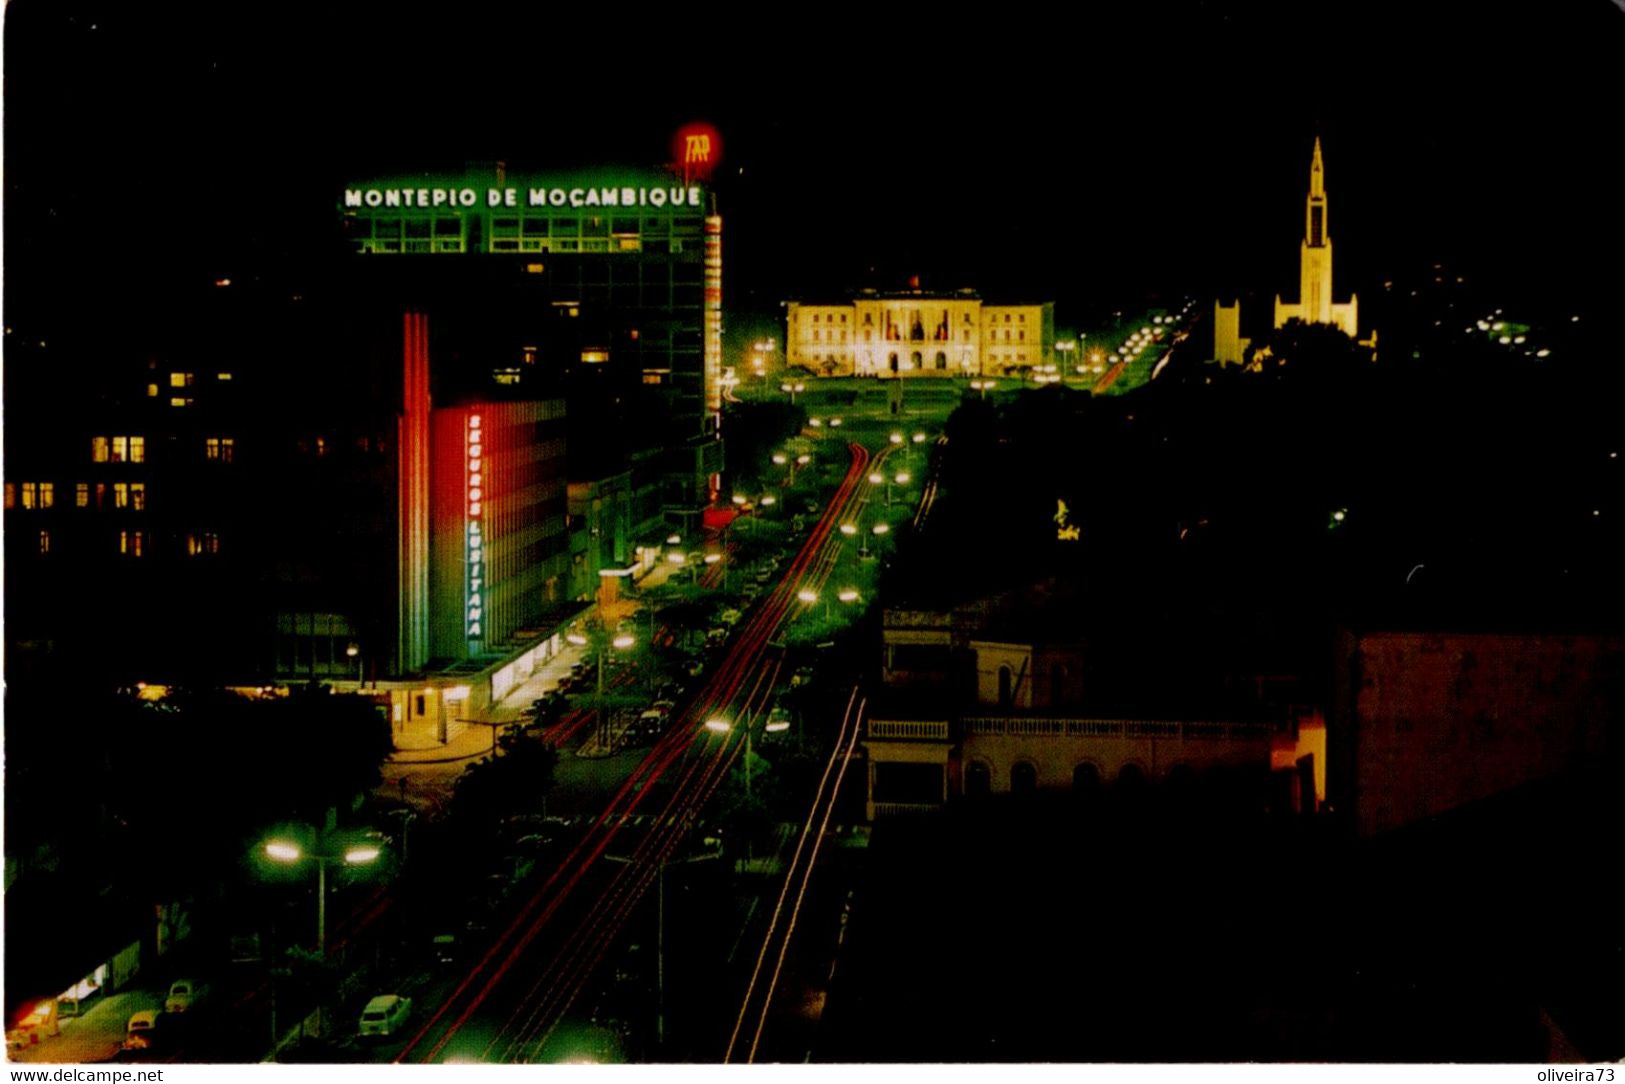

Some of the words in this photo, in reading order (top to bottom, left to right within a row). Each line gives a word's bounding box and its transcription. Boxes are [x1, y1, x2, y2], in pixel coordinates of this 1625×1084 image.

[685, 134, 710, 162] TAP
[344, 188, 477, 207] MONTEPIO
[488, 188, 517, 207] DE
[529, 187, 701, 208] MOÇAMBIQUE
[468, 415, 482, 516] SEGUROS
[468, 521, 482, 637] LUSITANA
